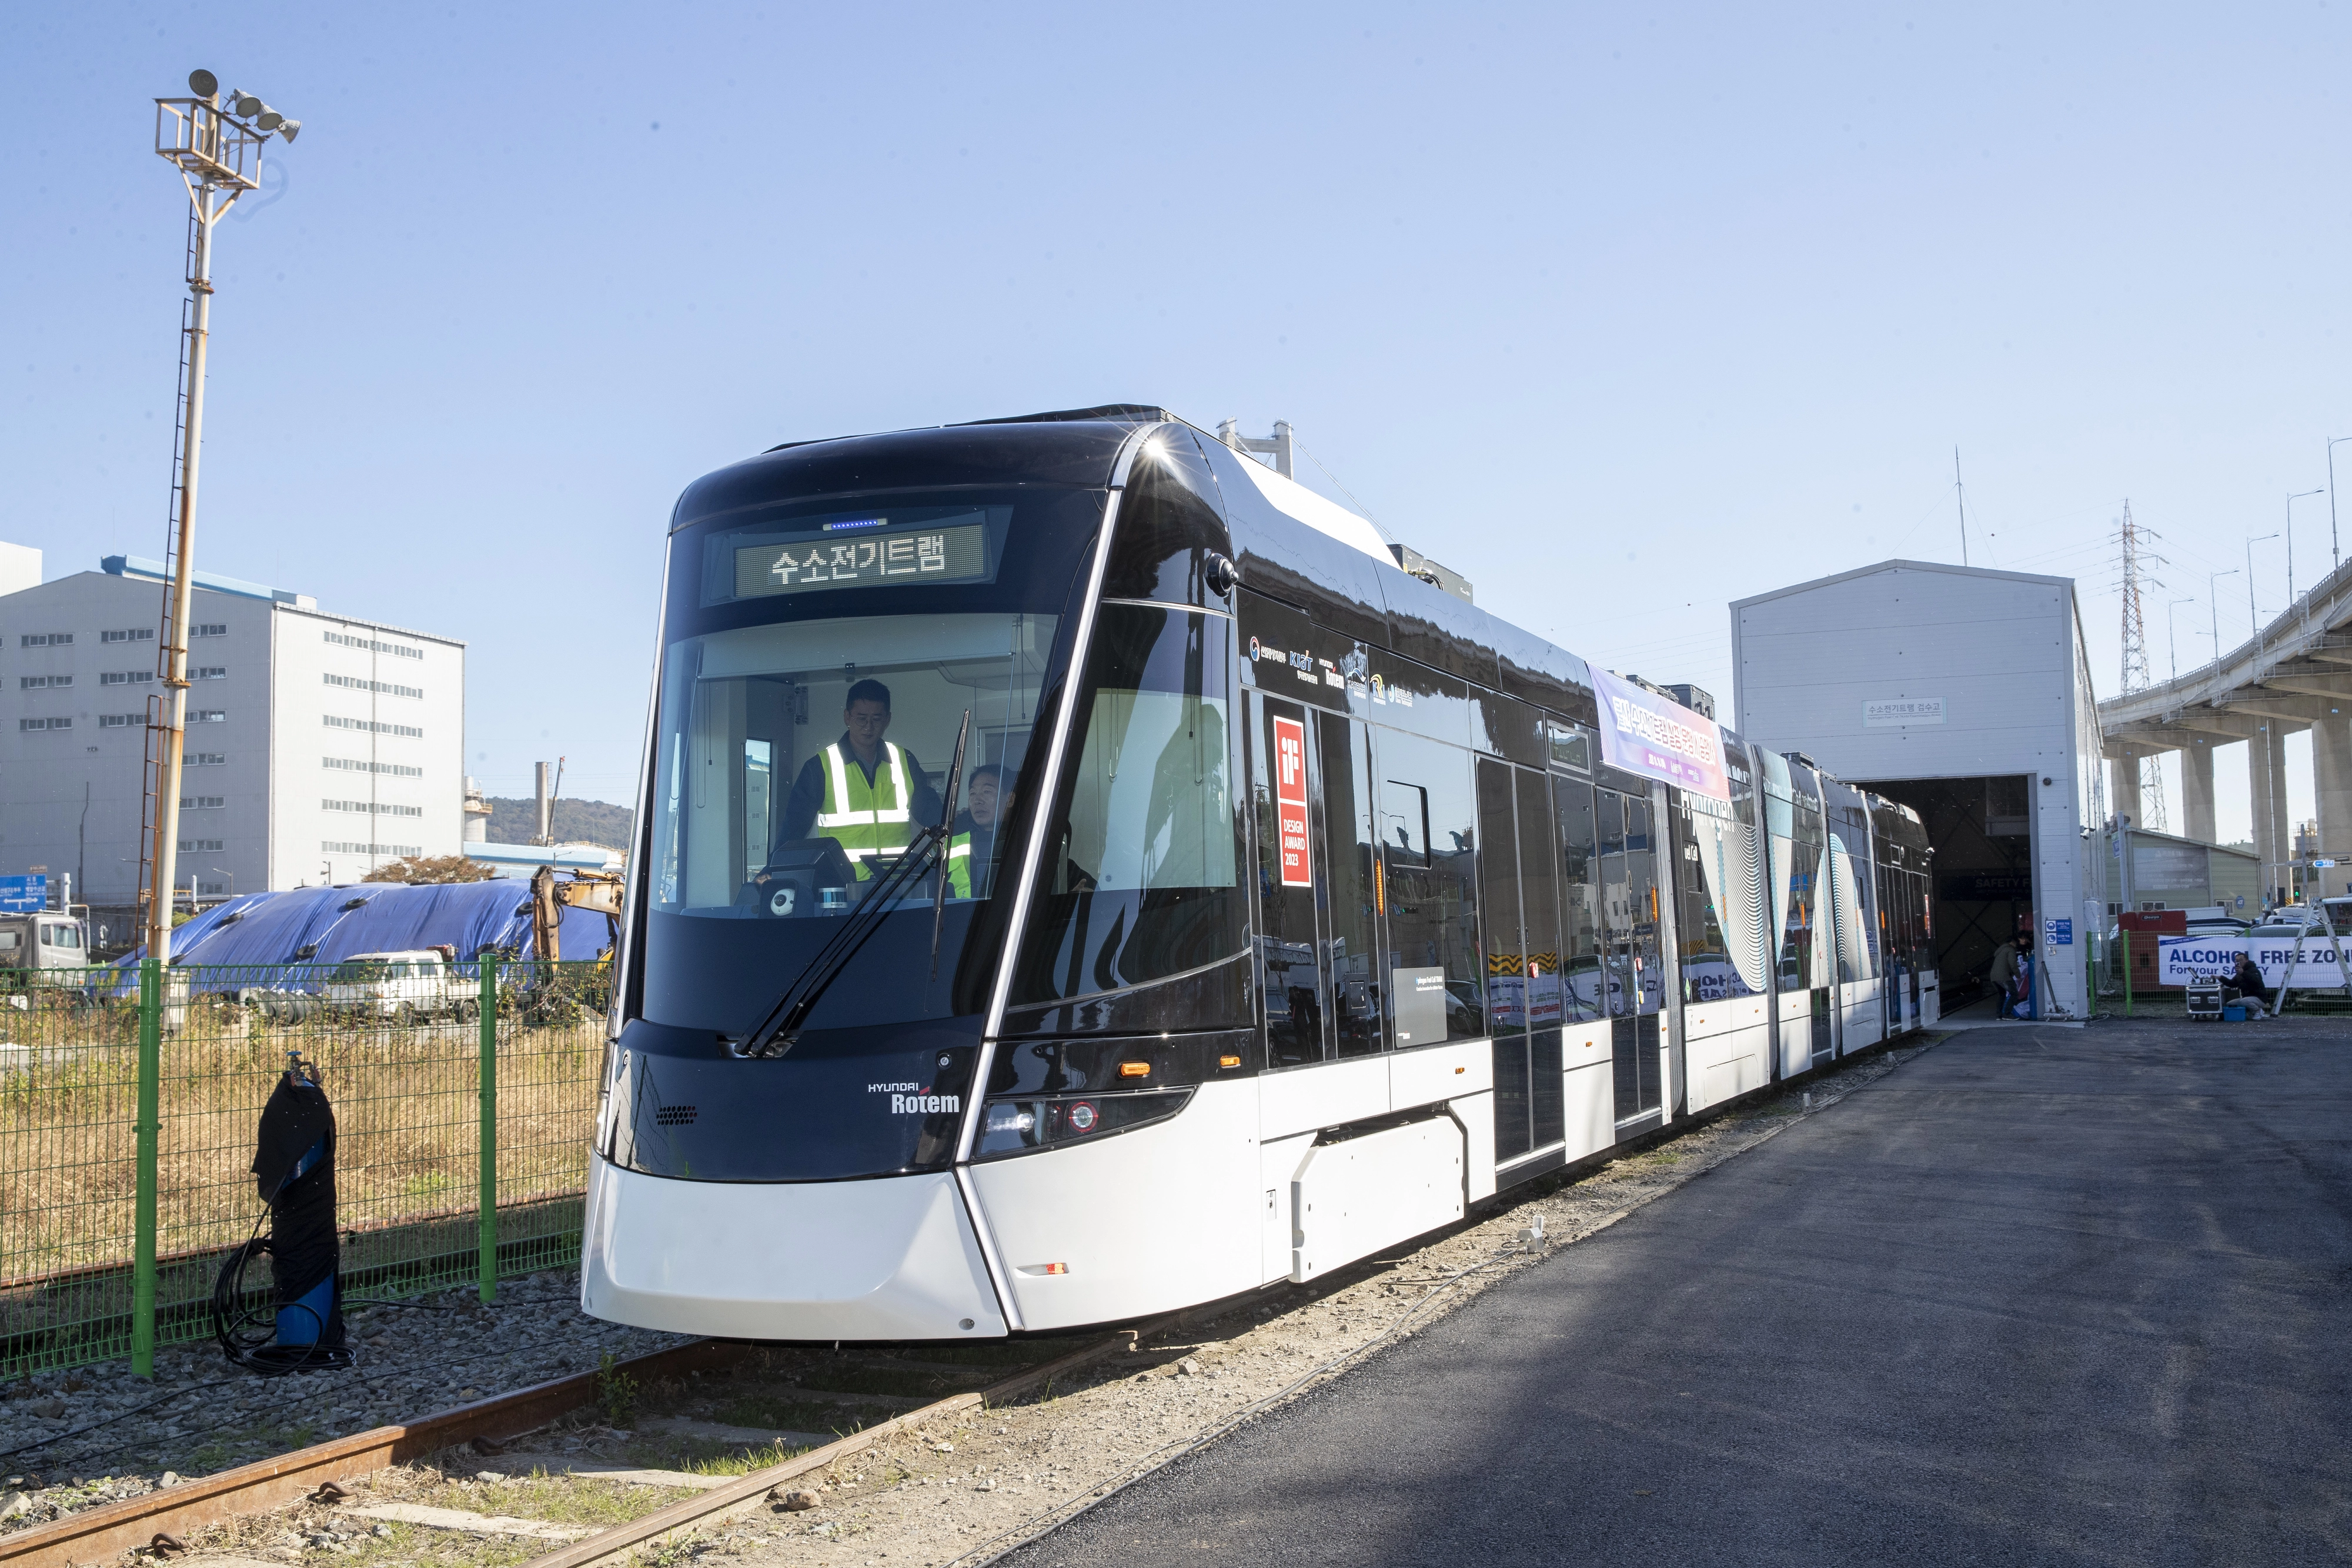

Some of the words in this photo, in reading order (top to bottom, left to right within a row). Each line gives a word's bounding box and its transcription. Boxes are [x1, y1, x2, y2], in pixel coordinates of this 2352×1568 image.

[771, 534, 945, 585] 수소전기트램
[1319, 658, 1334, 669] HYUNDAI
[1325, 668, 1345, 690] Rotem
[1869, 703, 1915, 714] 수소전기트램
[1917, 703, 1940, 712] 검수고
[1284, 818, 1304, 834] DESIGN
[1285, 835, 1305, 851] AWARD
[1285, 853, 1299, 867] 2023
[1975, 878, 2019, 888] SAFETY
[2261, 950, 2306, 964] FREE
[2312, 950, 2352, 963] ZON
[2170, 965, 2187, 974] For
[2193, 967, 2219, 977] your
[2223, 966, 2269, 975] SAY
[868, 1082, 920, 1092] HYUNDAI
[891, 1094, 960, 1114] Rotem
